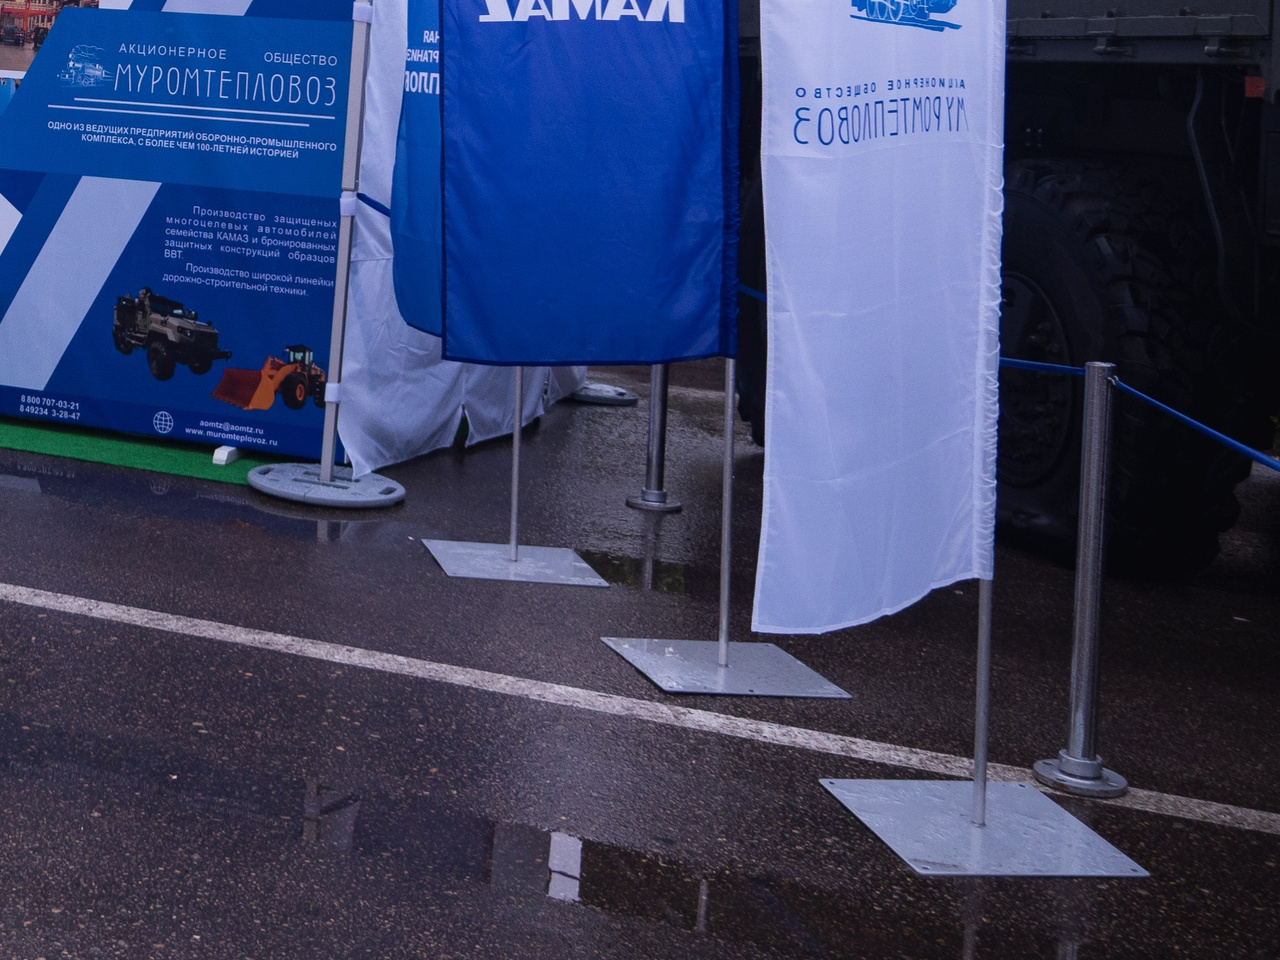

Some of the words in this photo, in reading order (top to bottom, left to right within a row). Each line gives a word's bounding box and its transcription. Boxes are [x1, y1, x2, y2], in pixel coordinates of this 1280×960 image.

[119, 43, 227, 60] АКЦИОНЕРНОЕ
[263, 51, 338, 67] ОБЩЕСТВО
[114, 63, 336, 106] МУРОМТЕПЛОВОЗ
[47, 121, 72, 131] ОДНО
[73, 123, 85, 131] ИЗ
[86, 124, 129, 135] ВЕДУЩИХ
[130, 127, 195, 140] ПРЕДПРИЯТИЙ
[195, 132, 337, 151] ОБОРОННО-ПРОМЫШЛЕННОГО
[81, 133, 136, 146] КОМПЛЕКСА,
[137, 138, 144, 146] С
[145, 138, 175, 149] БОЛЕЕ
[176, 141, 195, 150] ЧЕМ
[196, 143, 249, 155] 100-ЛЕТНЕЙ
[249, 147, 299, 159] ИСТОРИЕЙ
[193, 205, 266, 222] Производство
[274, 215, 337, 228] защищеных
[165, 228, 214, 240] семейства
[216, 231, 249, 243] КАМАЗ
[261, 235, 336, 251] бронированных
[166, 217, 248, 231] многоцелевых
[257, 225, 337, 240] автомобилей
[164, 239, 213, 250] защитных
[220, 245, 280, 258] конструкций
[288, 251, 336, 264] образцов
[164, 249, 184, 259] ВВТ.
[162, 273, 268, 292] дорожно-строительной
[269, 285, 309, 297] техники.
[185, 262, 250, 279] Производство
[251, 272, 293, 283] широкой
[294, 276, 334, 287] линейки
[19, 404, 24, 412] 8
[25, 406, 48, 415] 49234
[51, 409, 81, 420] 3-28-47
[21, 394, 26, 403] 8
[26, 395, 41, 405] 800
[41, 397, 80, 410] 707-03-21
[199, 420, 264, 435] aomtz@aomtz.ru
